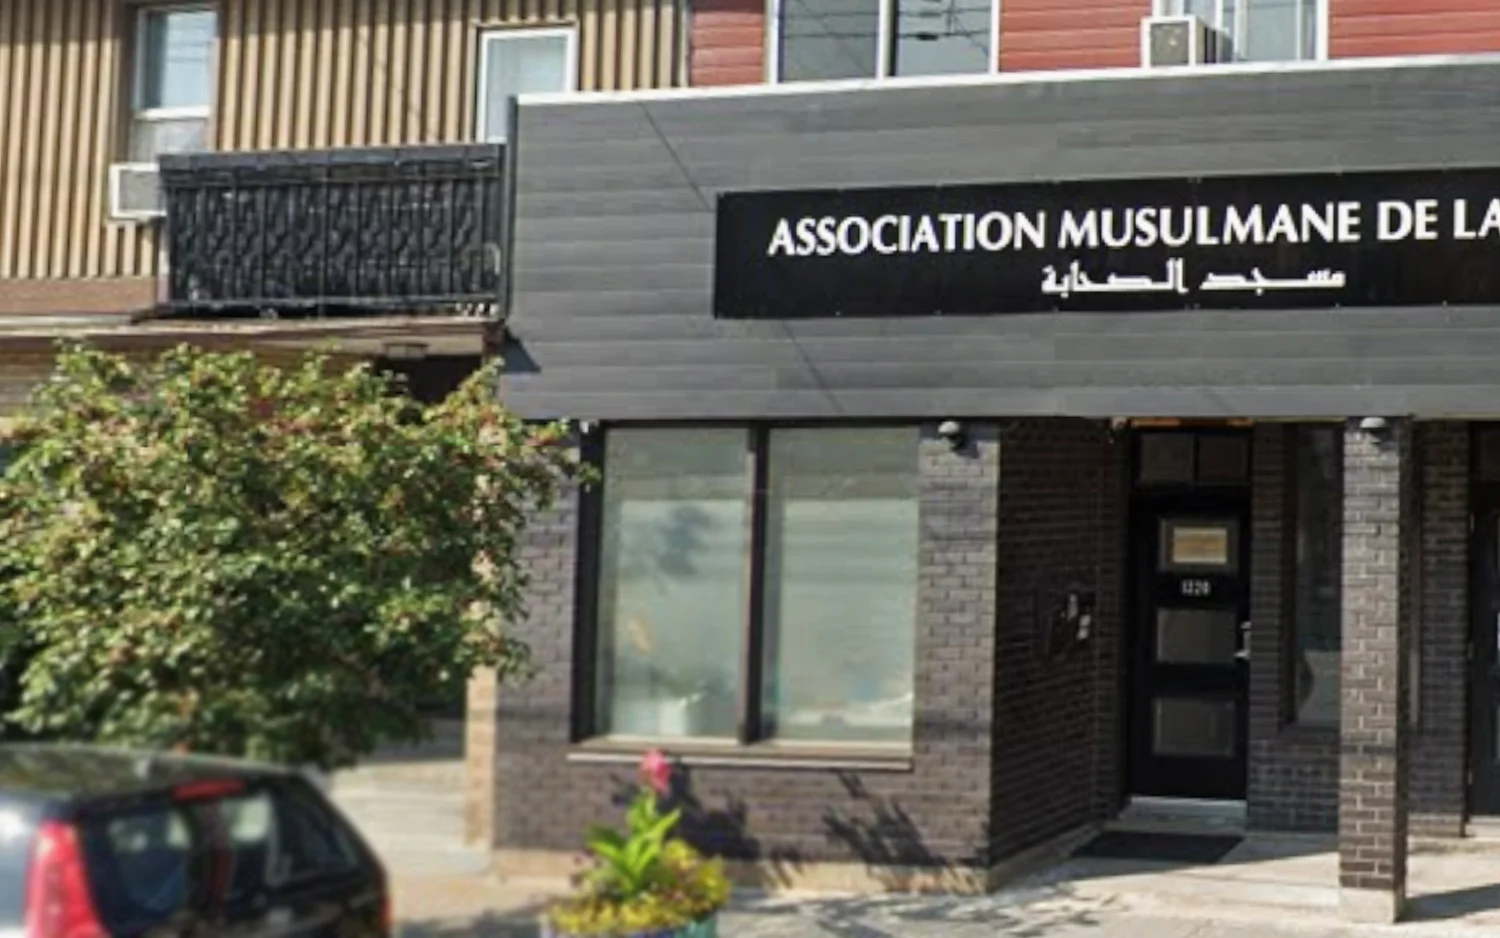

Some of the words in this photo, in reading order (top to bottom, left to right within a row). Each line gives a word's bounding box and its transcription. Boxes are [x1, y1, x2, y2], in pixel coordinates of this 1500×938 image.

[767, 211, 1047, 256] ASSOCIATION
[1057, 201, 1361, 250] MUSULMANE
[1376, 198, 1439, 241] DE
[1041, 257, 1189, 299] الصحابة
[1199, 266, 1347, 296] مسجد
